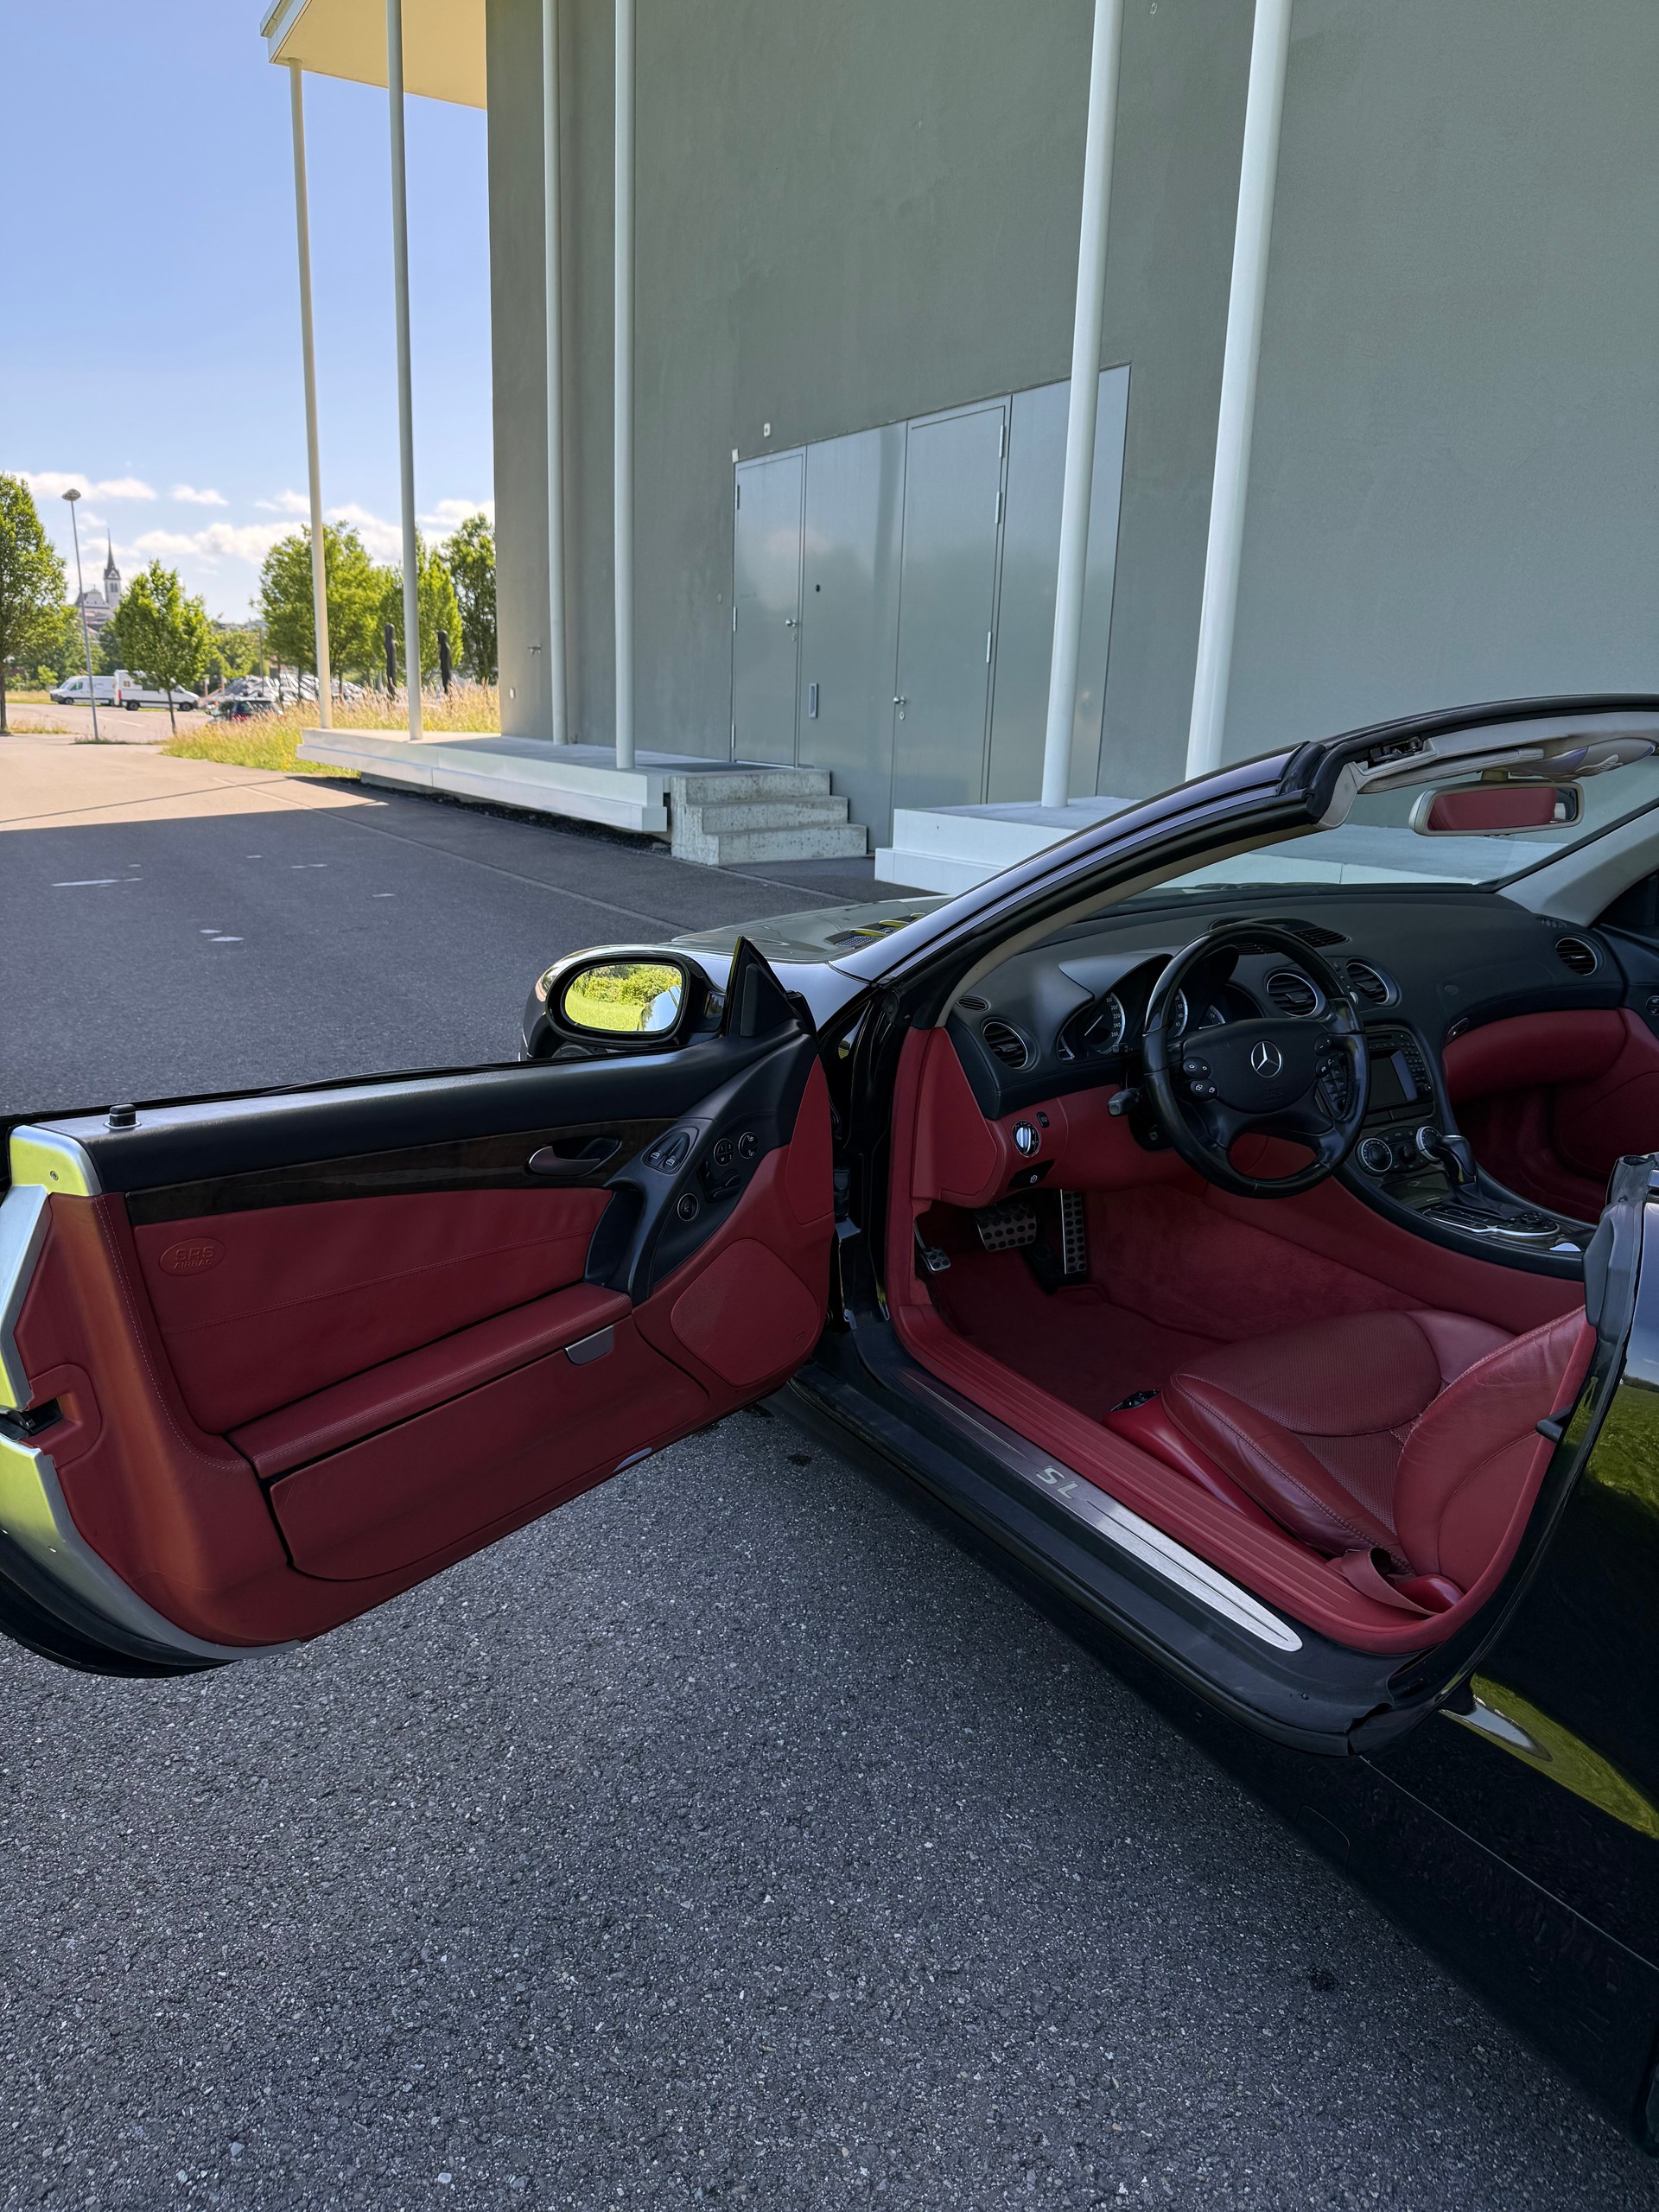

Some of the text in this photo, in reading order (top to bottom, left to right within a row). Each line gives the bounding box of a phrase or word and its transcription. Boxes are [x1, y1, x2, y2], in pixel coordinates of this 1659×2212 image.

[175, 1246, 214, 1261] SRS
[173, 1259, 213, 1269] AIRBAG
[1036, 1465, 1079, 1499] SL
